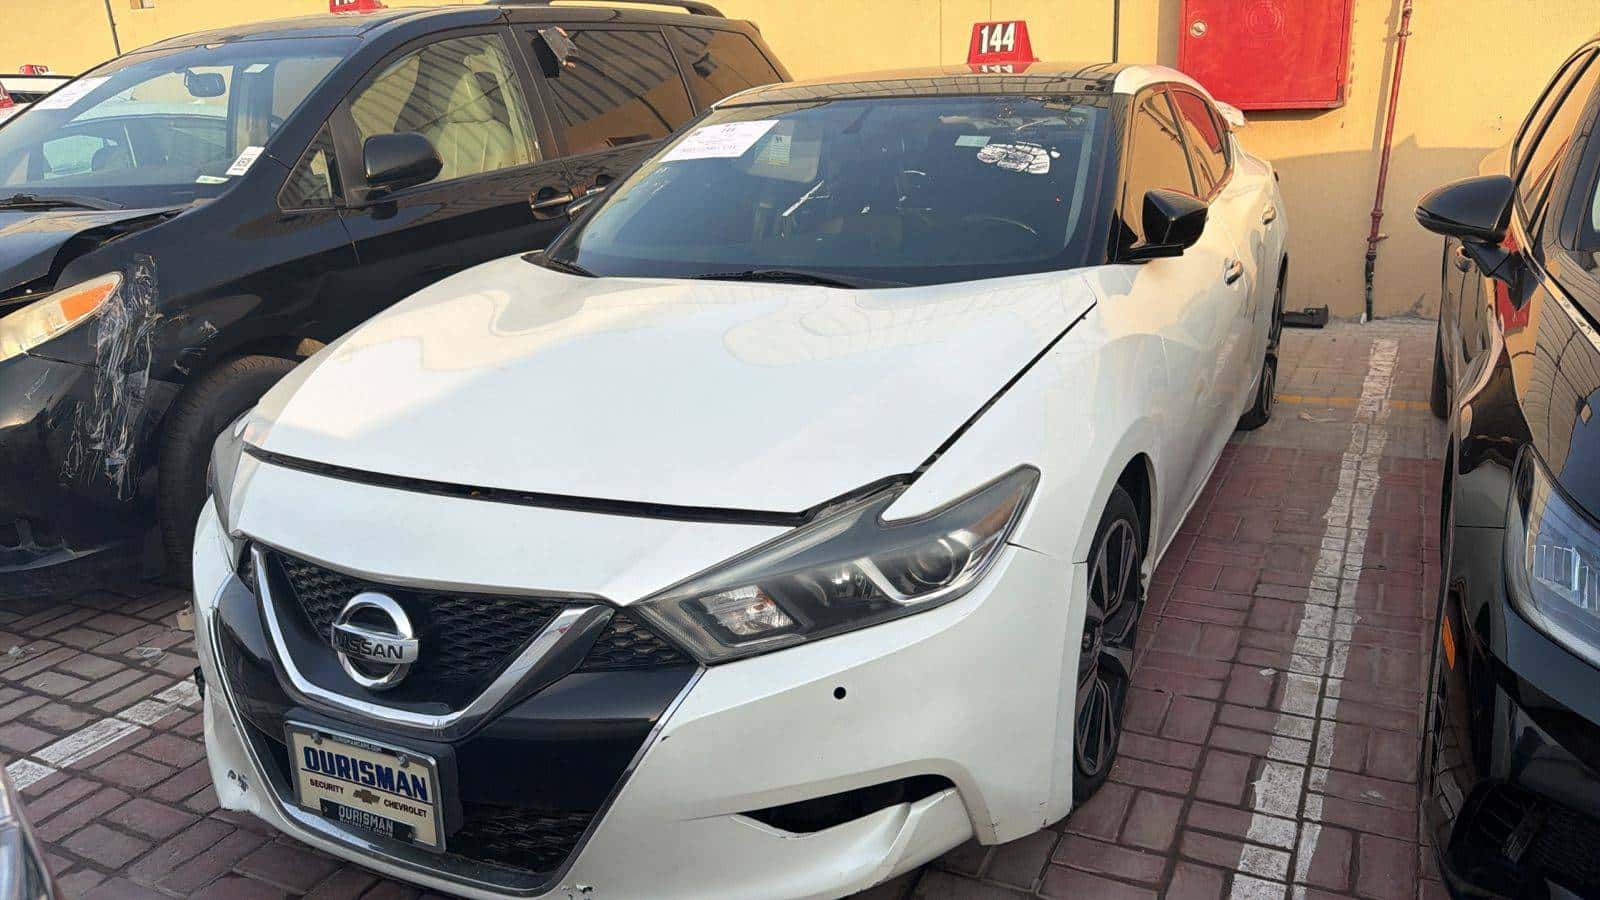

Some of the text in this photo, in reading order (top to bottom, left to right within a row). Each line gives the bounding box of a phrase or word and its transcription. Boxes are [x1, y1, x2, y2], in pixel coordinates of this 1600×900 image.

[981, 22, 1015, 54] 144
[335, 631, 403, 659] NISSAN
[303, 747, 427, 800] OURISMAN
[309, 778, 427, 818] SECURITY CHEVROLET
[338, 805, 394, 833] OURISMAN
